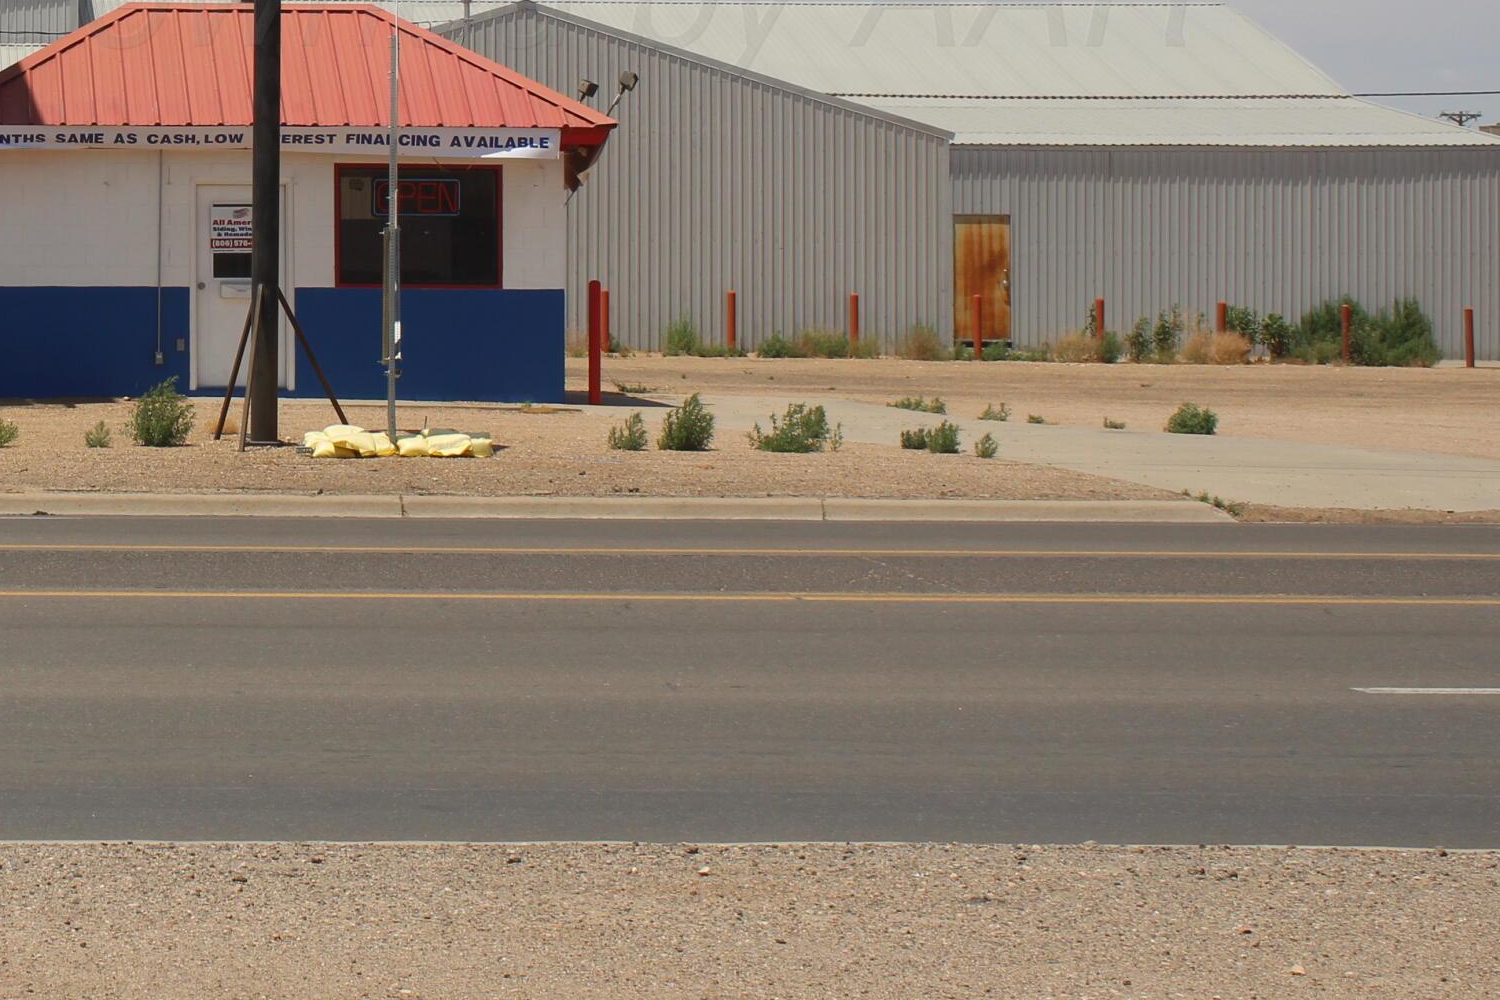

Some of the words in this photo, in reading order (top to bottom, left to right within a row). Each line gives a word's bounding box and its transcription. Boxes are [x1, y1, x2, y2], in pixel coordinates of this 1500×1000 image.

[55, 133, 104, 144] SAME
[114, 133, 138, 144] AS
[146, 133, 201, 146] CASH,
[203, 133, 245, 144] LOW
[280, 134, 337, 145] EREST
[450, 135, 549, 149] AVAILABLE
[377, 181, 459, 213] OPEN
